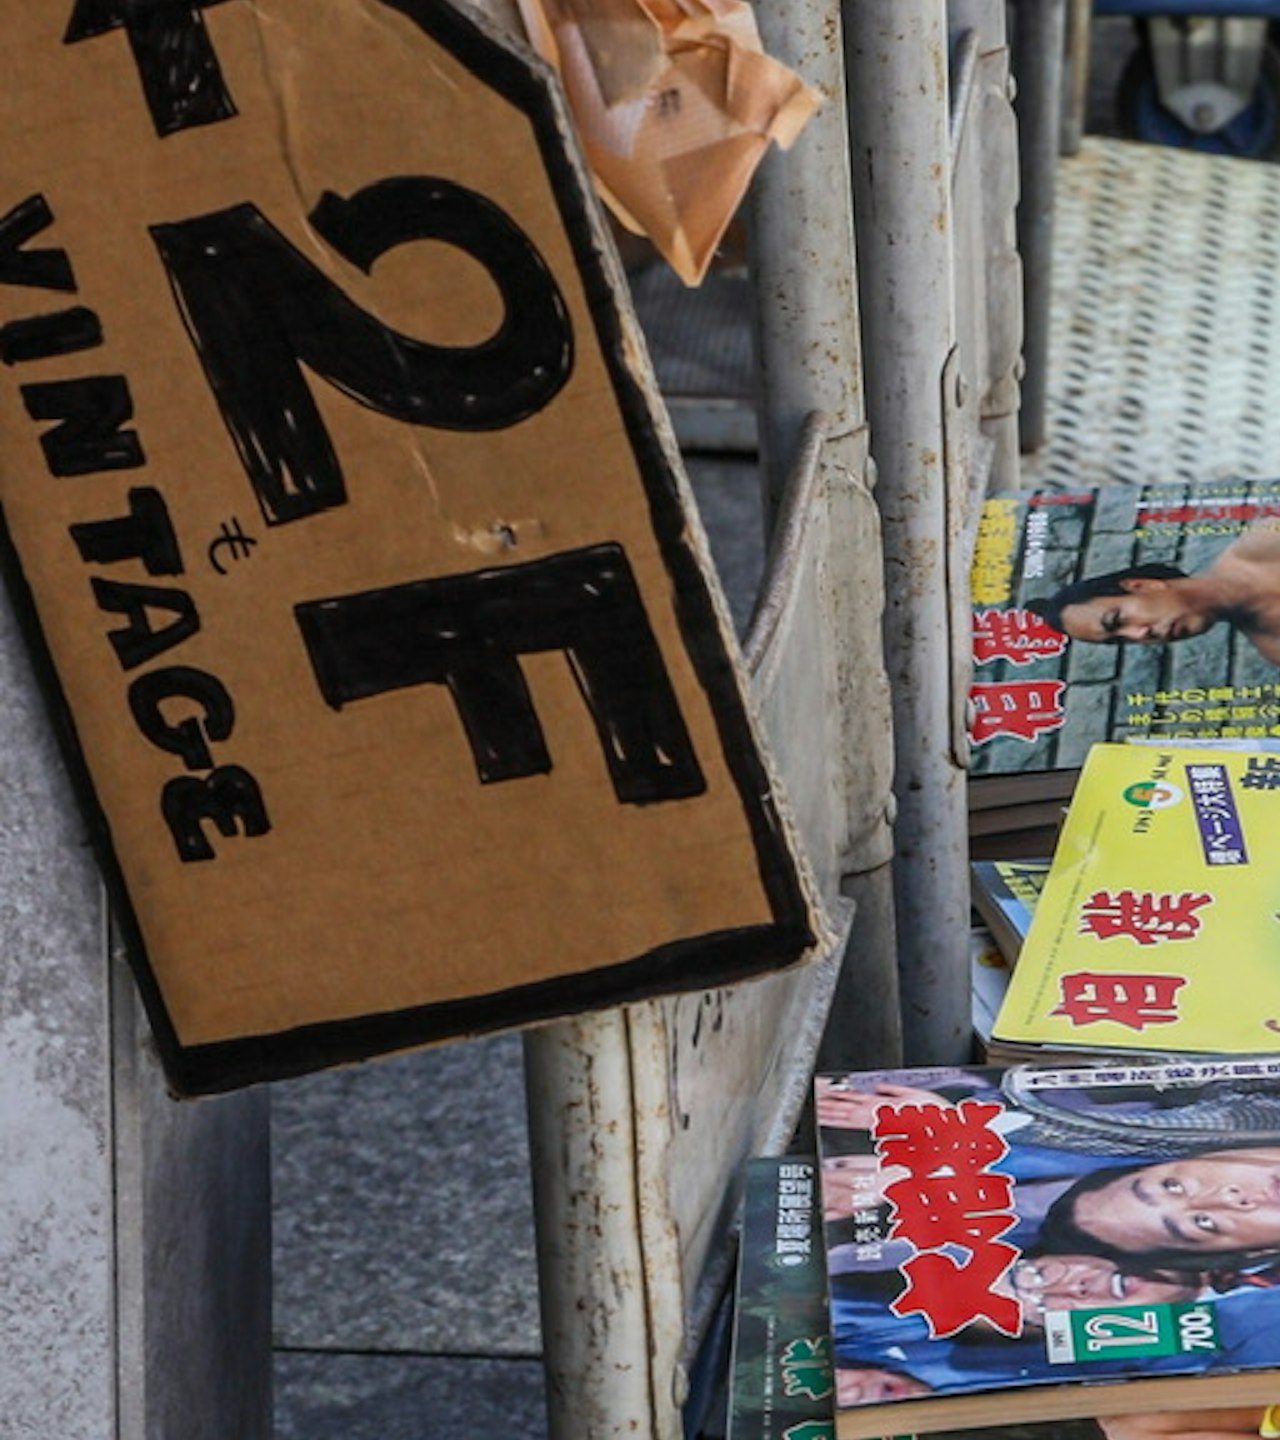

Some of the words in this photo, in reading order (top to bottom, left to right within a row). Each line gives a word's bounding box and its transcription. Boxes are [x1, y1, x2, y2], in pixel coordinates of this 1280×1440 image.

[0, 190, 274, 866] VINTAGE
[149, 174, 710, 806] 2F
[967, 607, 1069, 746] 相撲
[1130, 786, 1173, 804] 5
[1050, 887, 1215, 1031] 相撲
[870, 1099, 1025, 1340] 大相撲
[1083, 1311, 1160, 1352] 12
